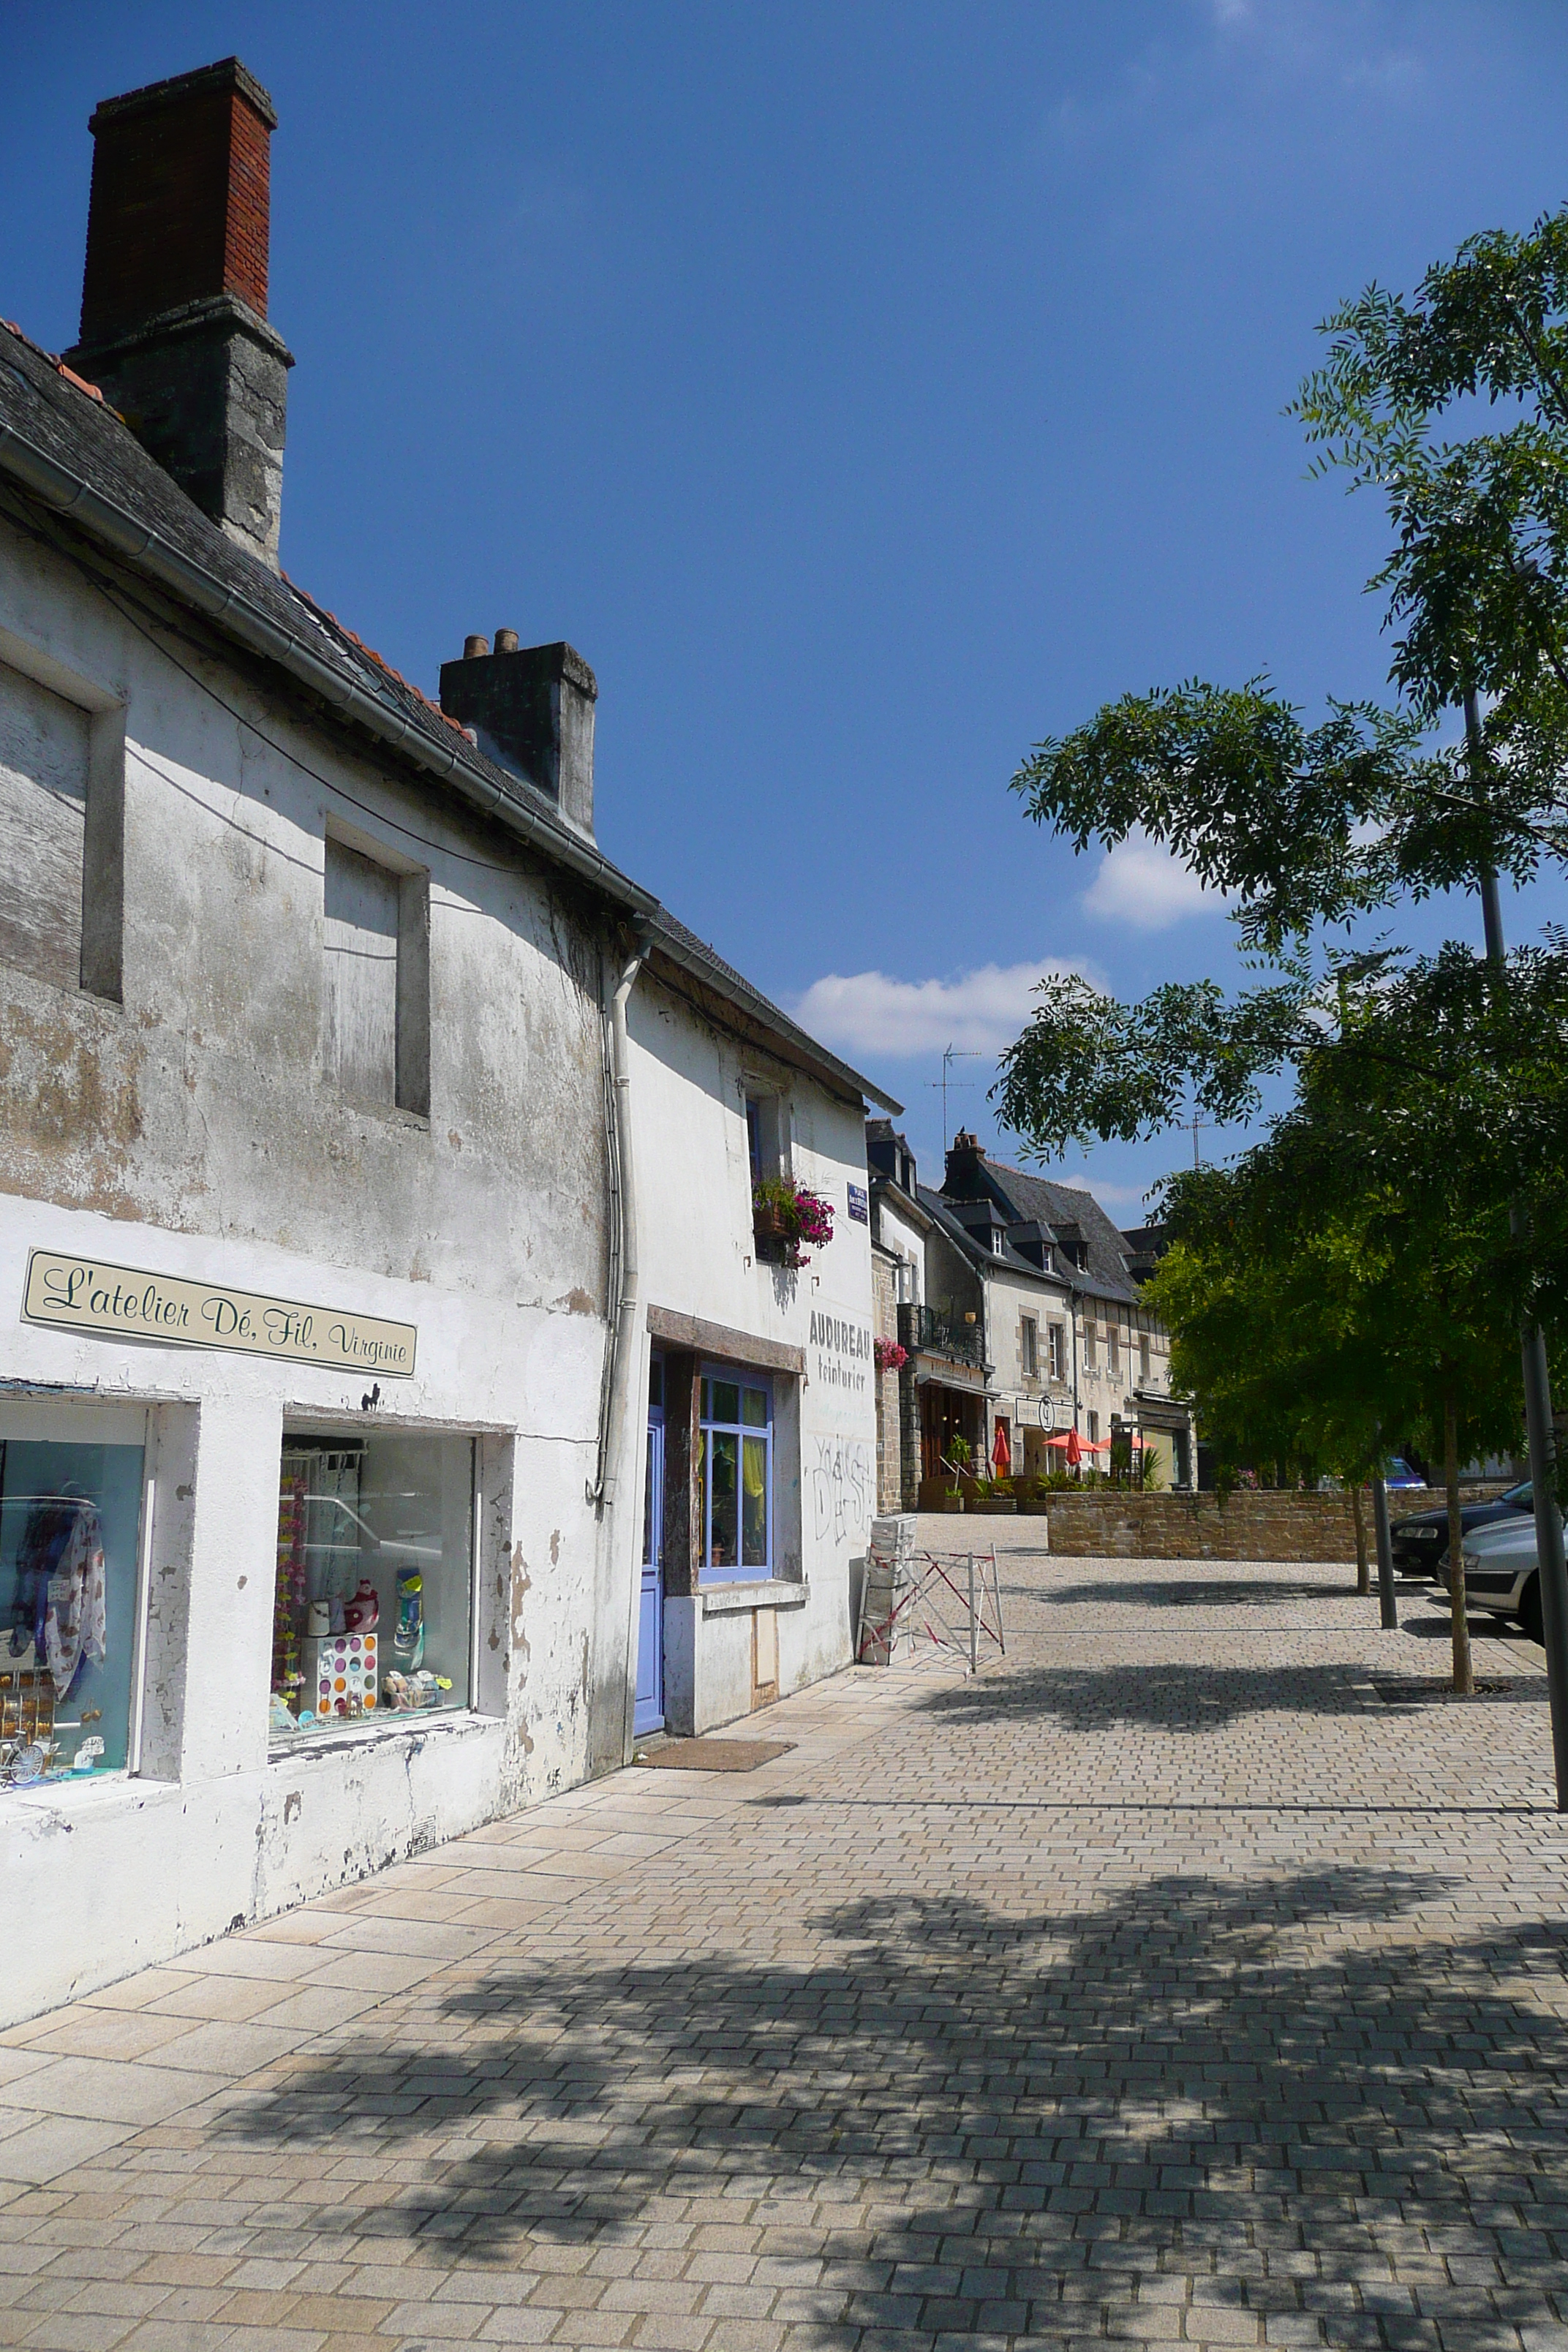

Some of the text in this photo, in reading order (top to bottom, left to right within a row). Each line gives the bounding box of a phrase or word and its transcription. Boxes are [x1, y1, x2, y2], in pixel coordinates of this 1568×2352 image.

[44, 1267, 407, 1364] L'atelier Dé, Fil, Virginie
[810, 1311, 870, 1360] AUDUREAU
[818, 1354, 865, 1392] teinturier
